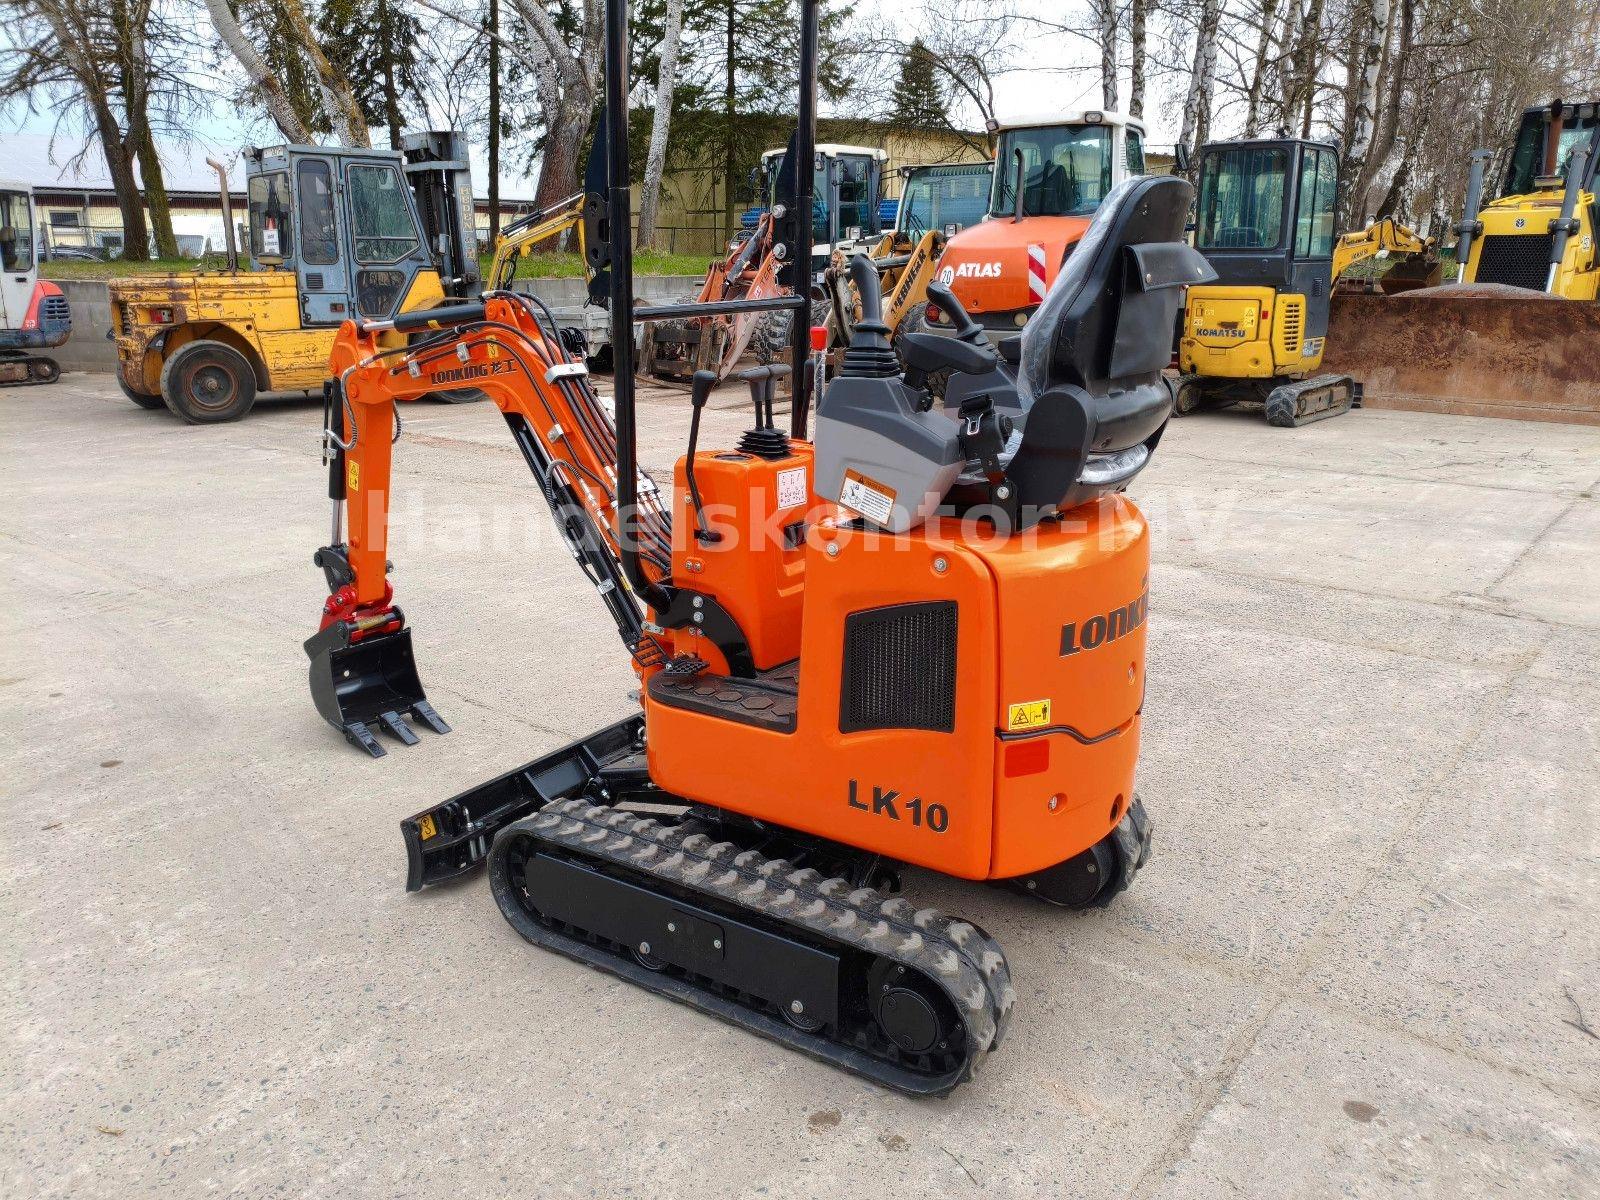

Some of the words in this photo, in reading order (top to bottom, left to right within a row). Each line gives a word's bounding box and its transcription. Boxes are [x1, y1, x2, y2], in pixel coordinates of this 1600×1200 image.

[941, 269, 952, 285] 20
[956, 262, 1001, 278] ATLAS
[1196, 328, 1246, 338] KOMATSU
[848, 779, 949, 834] LK10
